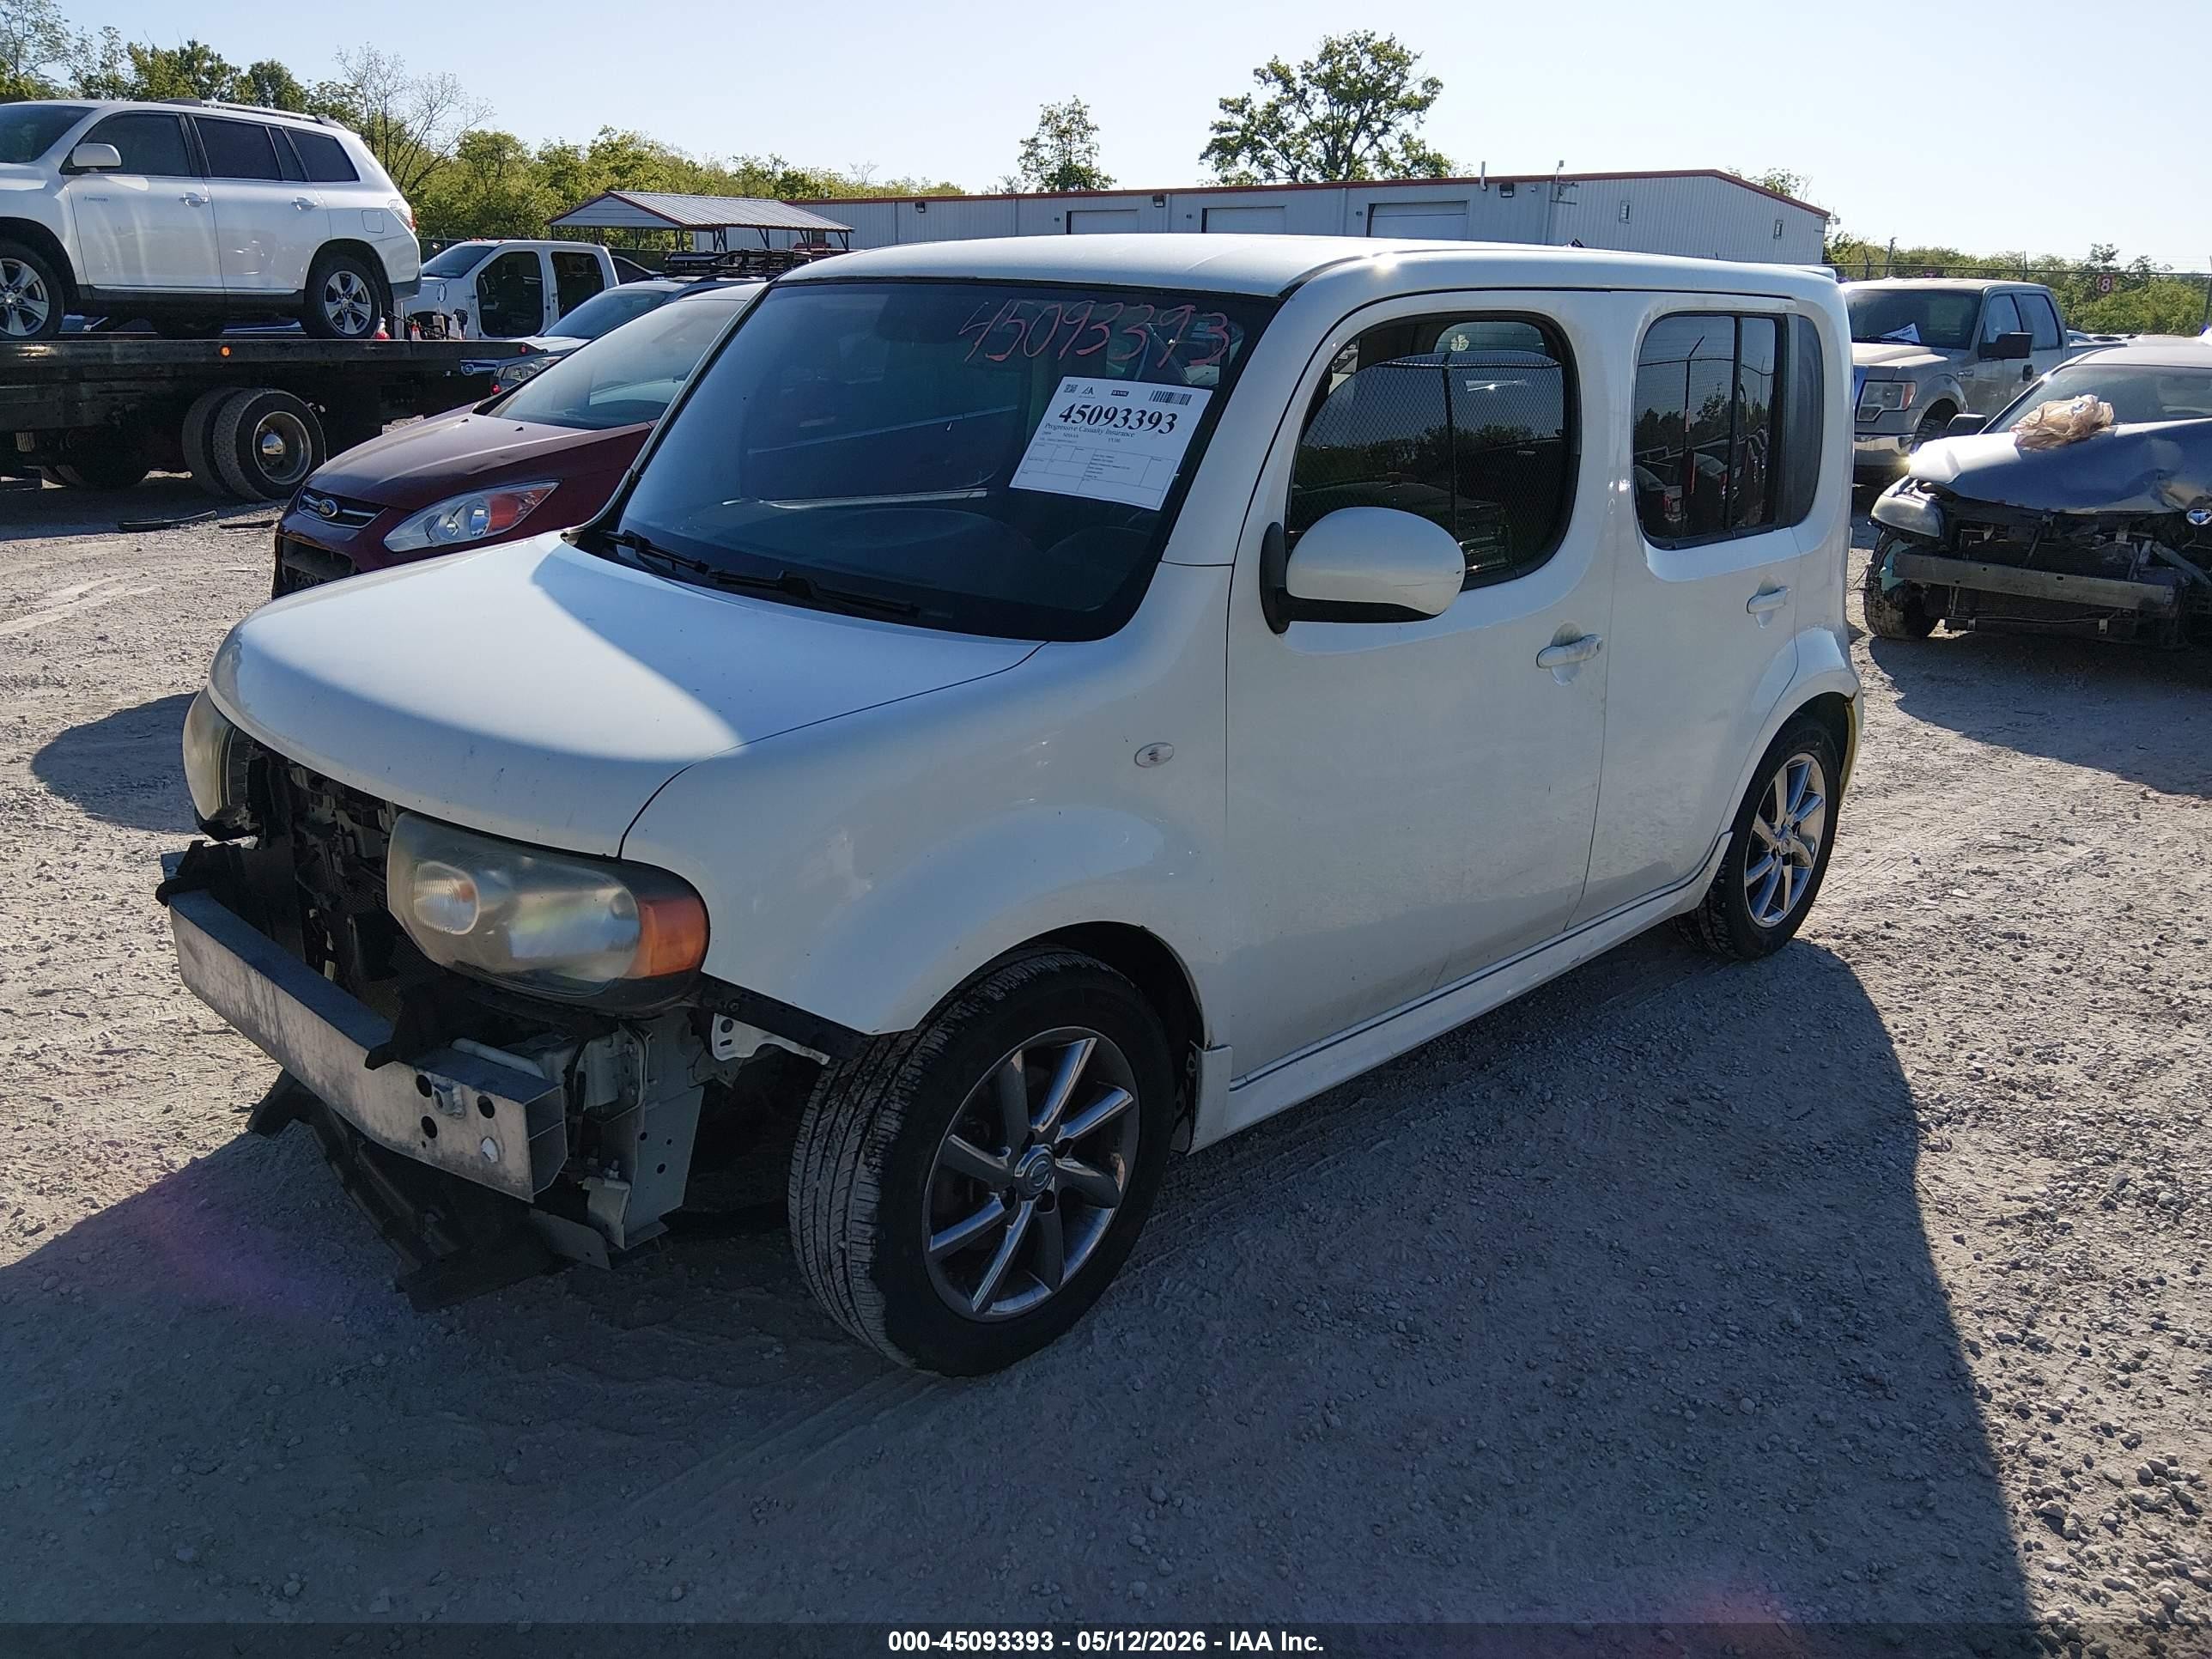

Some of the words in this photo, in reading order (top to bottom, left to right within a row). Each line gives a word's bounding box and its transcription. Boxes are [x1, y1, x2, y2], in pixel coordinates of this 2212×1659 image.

[2100, 277, 2111, 292] 8
[958, 299, 1231, 369] 45093393
[1044, 422, 1078, 432] Progressive
[1079, 426, 1104, 436] Casualty
[1105, 428, 1136, 438] Insurance
[1058, 403, 1179, 434] 45093393
